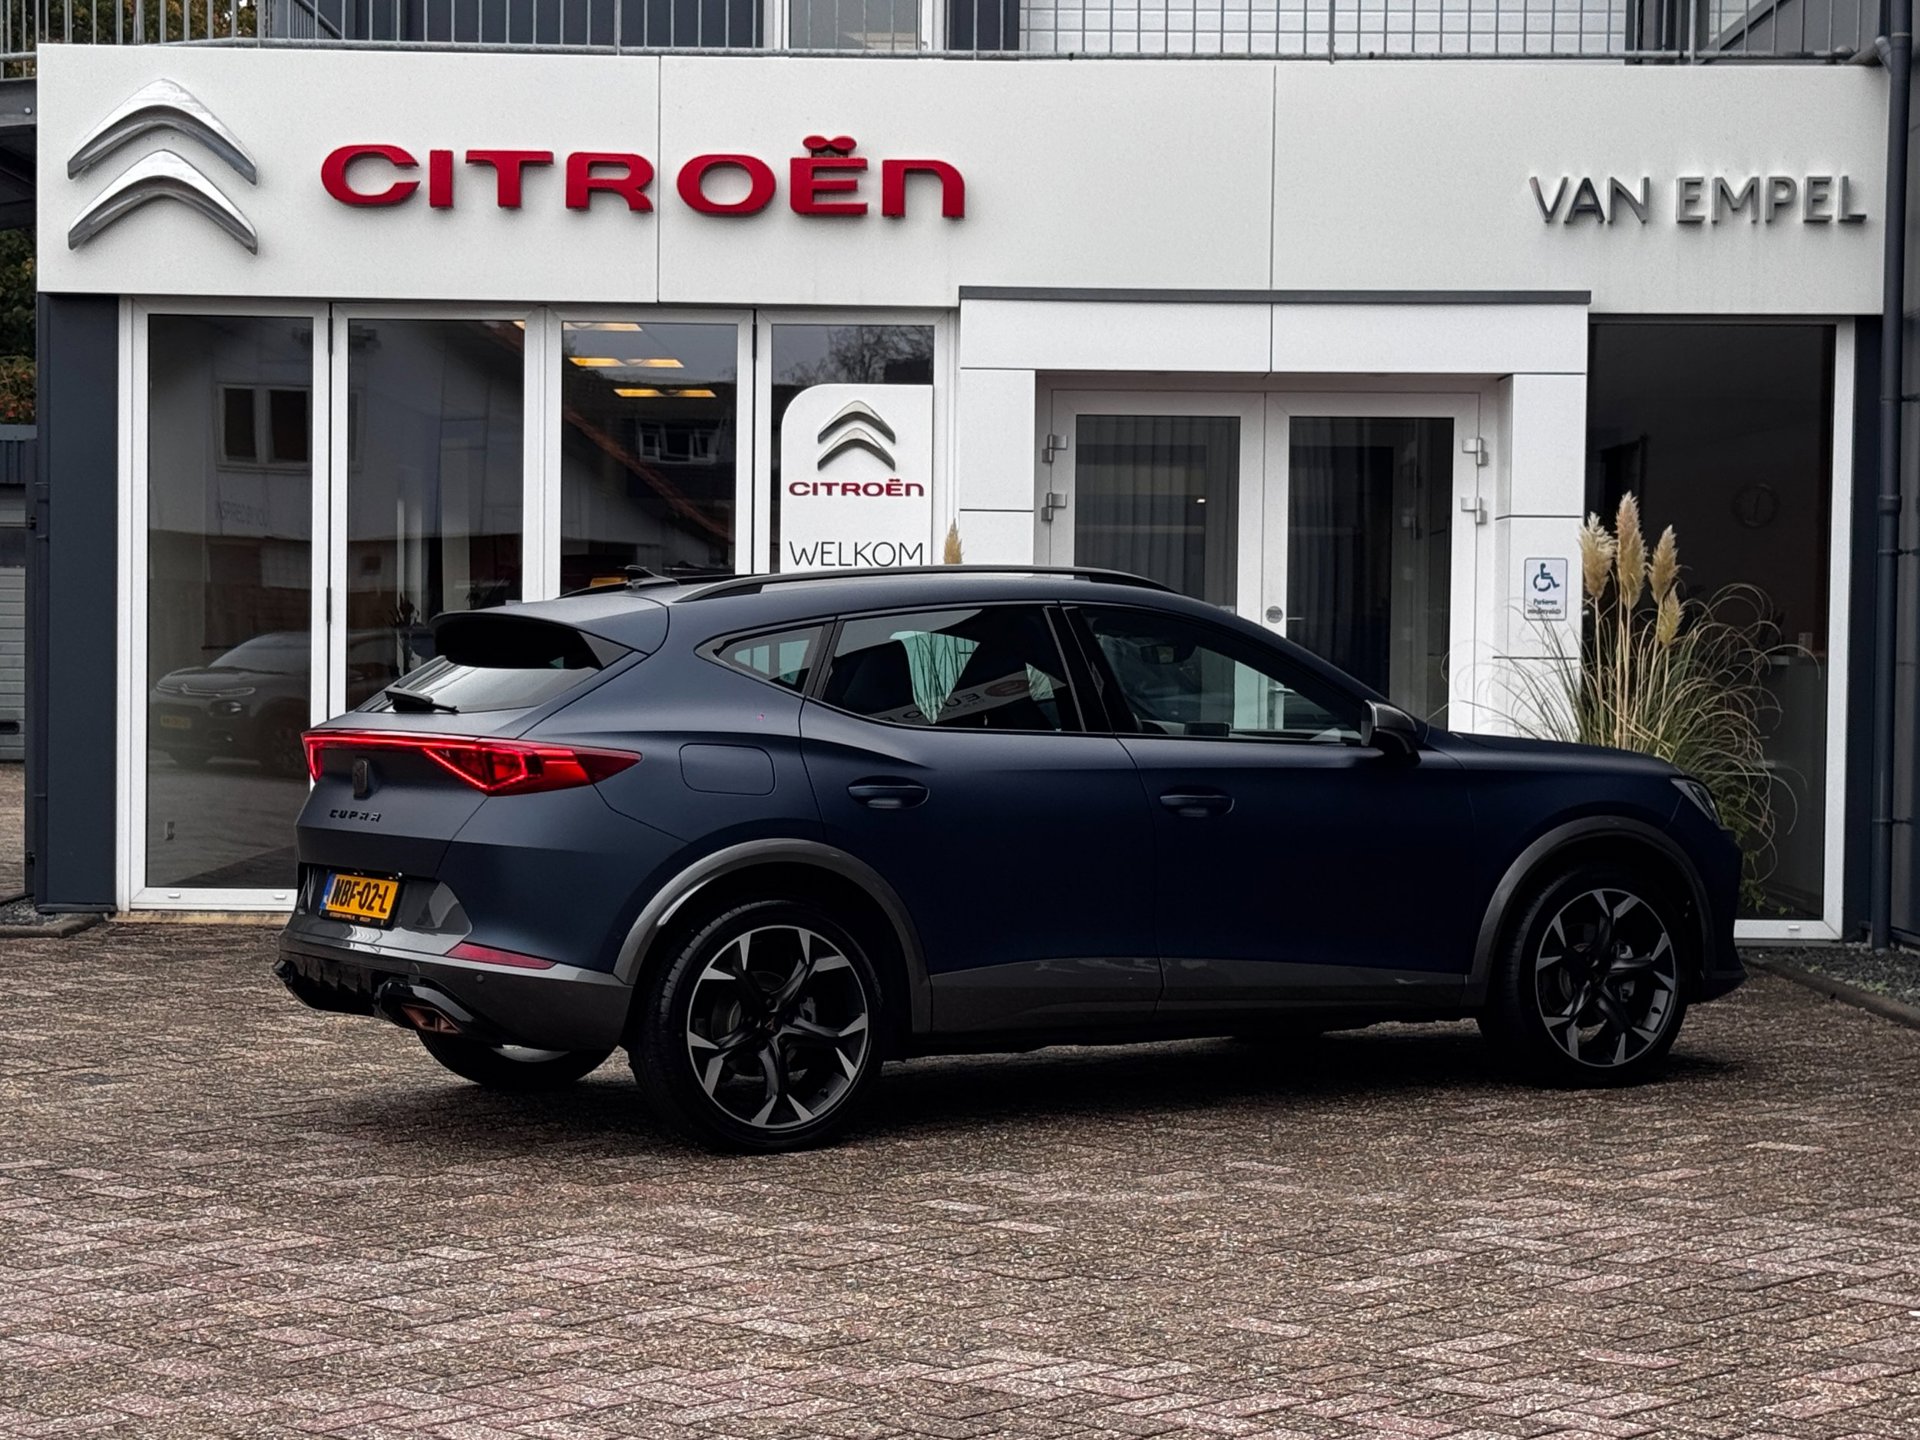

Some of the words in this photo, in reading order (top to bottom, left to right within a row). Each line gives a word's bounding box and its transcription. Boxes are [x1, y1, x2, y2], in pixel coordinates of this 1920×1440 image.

[1529, 176, 1650, 225] VAN
[1675, 176, 1867, 225] EMPEL
[789, 541, 924, 567] WELKOM
[329, 809, 382, 823] CUPRA
[330, 878, 389, 914] NBF-02-L
